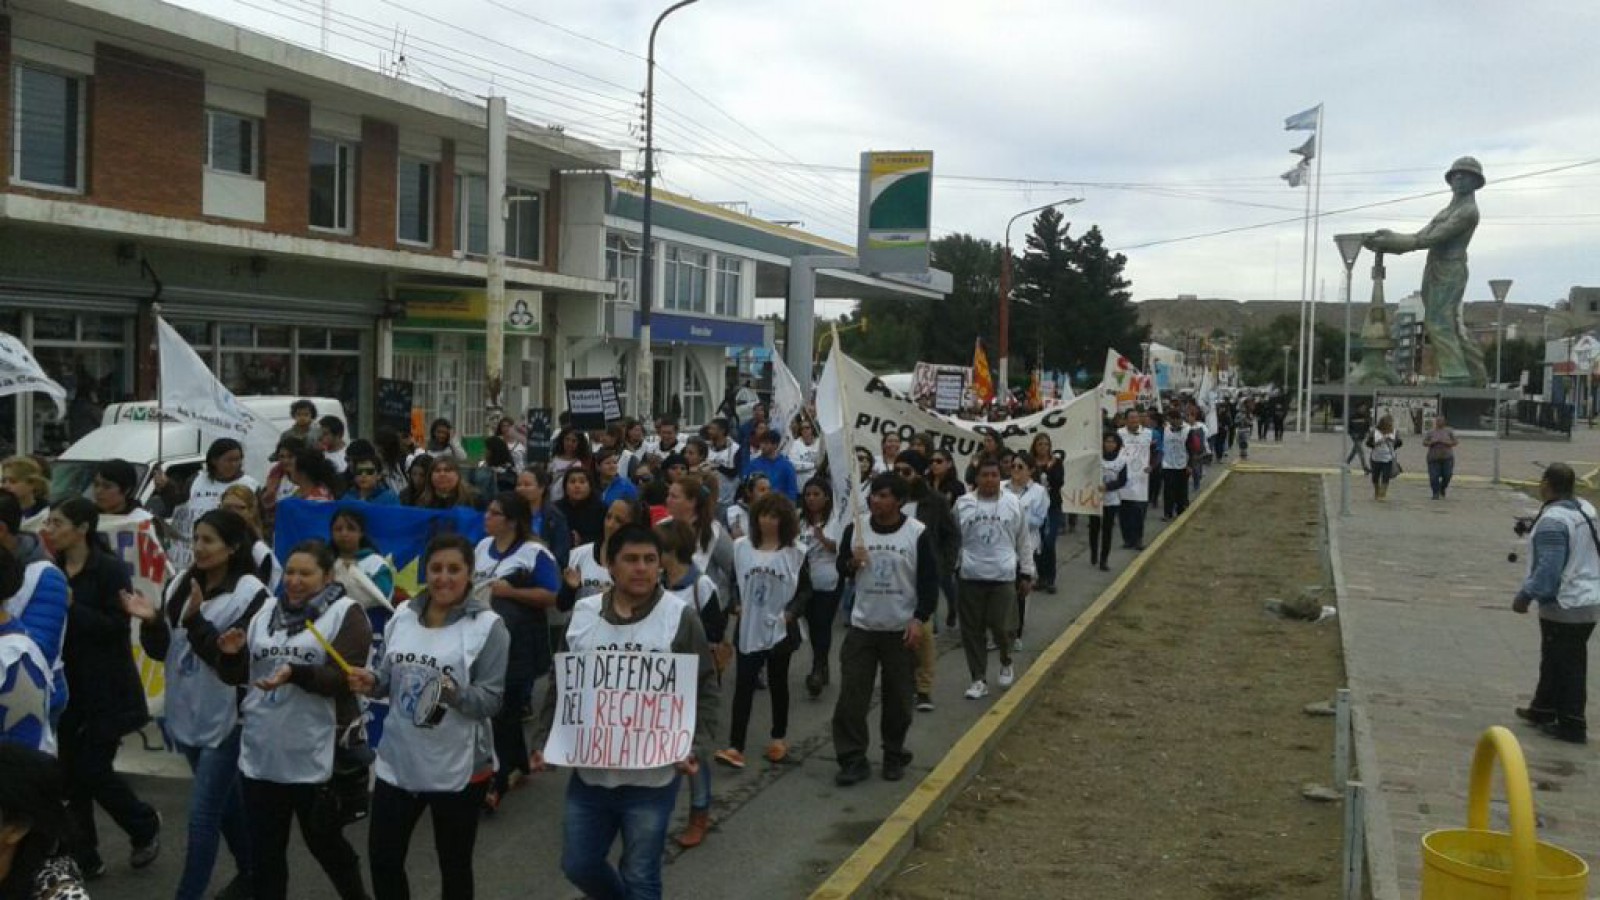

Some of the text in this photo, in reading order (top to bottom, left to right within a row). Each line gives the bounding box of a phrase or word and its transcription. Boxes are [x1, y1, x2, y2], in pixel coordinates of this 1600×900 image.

[855, 411, 916, 442] PICO
[565, 655, 677, 693] EN DEFENSA
[562, 690, 684, 730] DEL REGIMEN
[566, 726, 690, 767] JUBILATORIO
